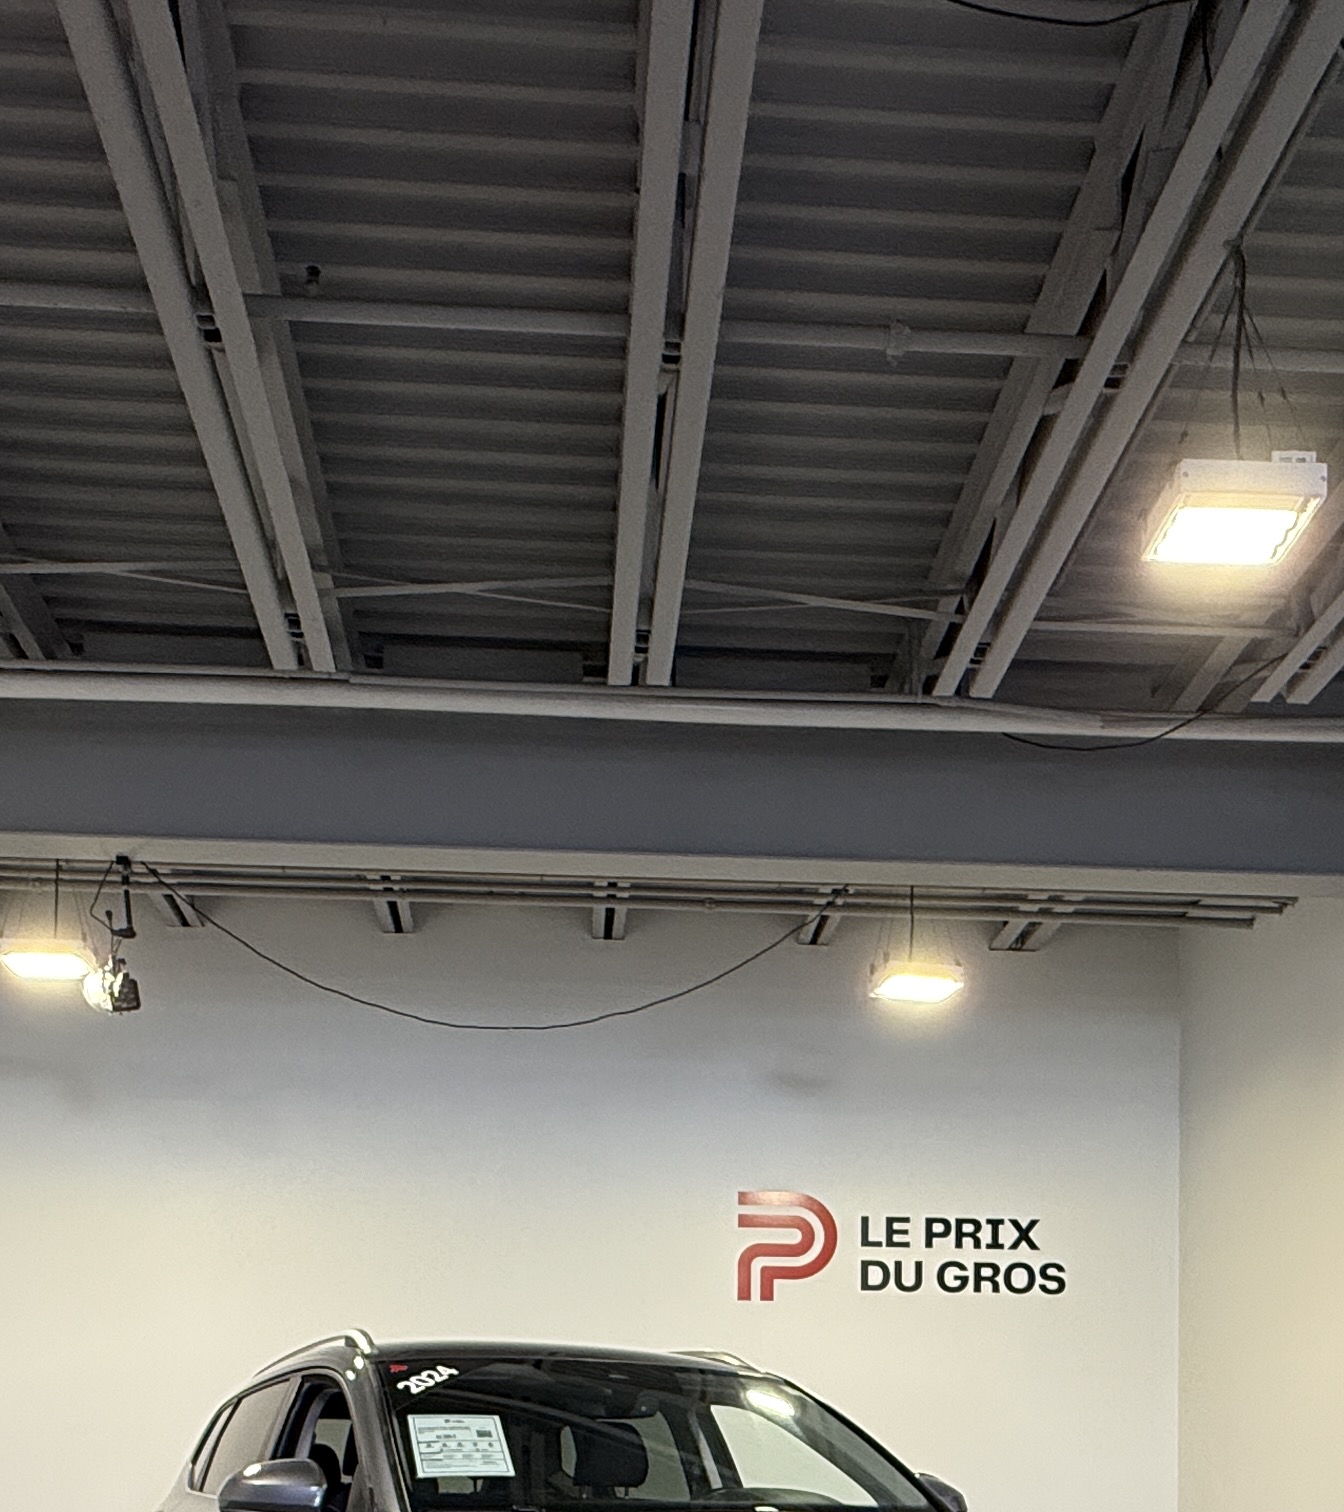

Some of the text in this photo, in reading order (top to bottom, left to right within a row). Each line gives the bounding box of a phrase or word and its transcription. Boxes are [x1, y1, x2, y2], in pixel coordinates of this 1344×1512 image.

[860, 1216, 1041, 1250] LE PRIX
[860, 1260, 1066, 1295] DU GROS
[397, 1365, 459, 1394] 2024
